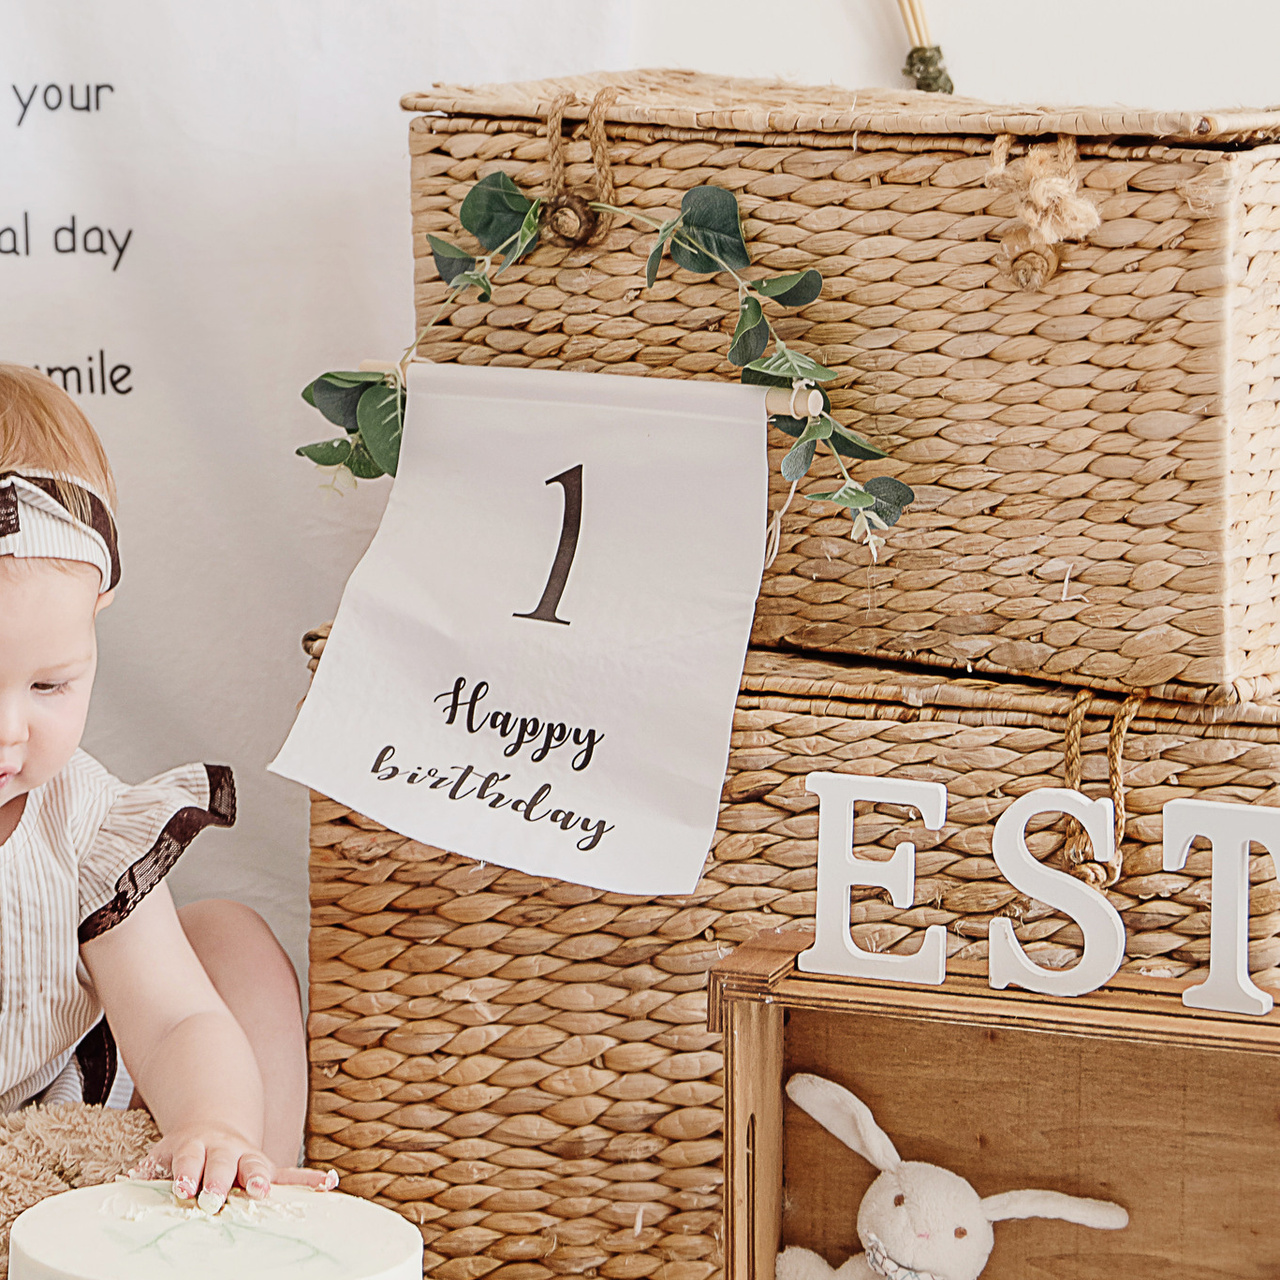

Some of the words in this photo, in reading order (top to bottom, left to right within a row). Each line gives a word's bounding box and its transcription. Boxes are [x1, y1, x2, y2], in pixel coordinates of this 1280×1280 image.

[12, 83, 115, 127] your
[53, 214, 134, 273] day
[34, 348, 134, 396] mile
[511, 463, 585, 627] 1
[433, 676, 606, 772] Happy
[370, 745, 616, 852] birthday
[796, 770, 1280, 1016] EST
